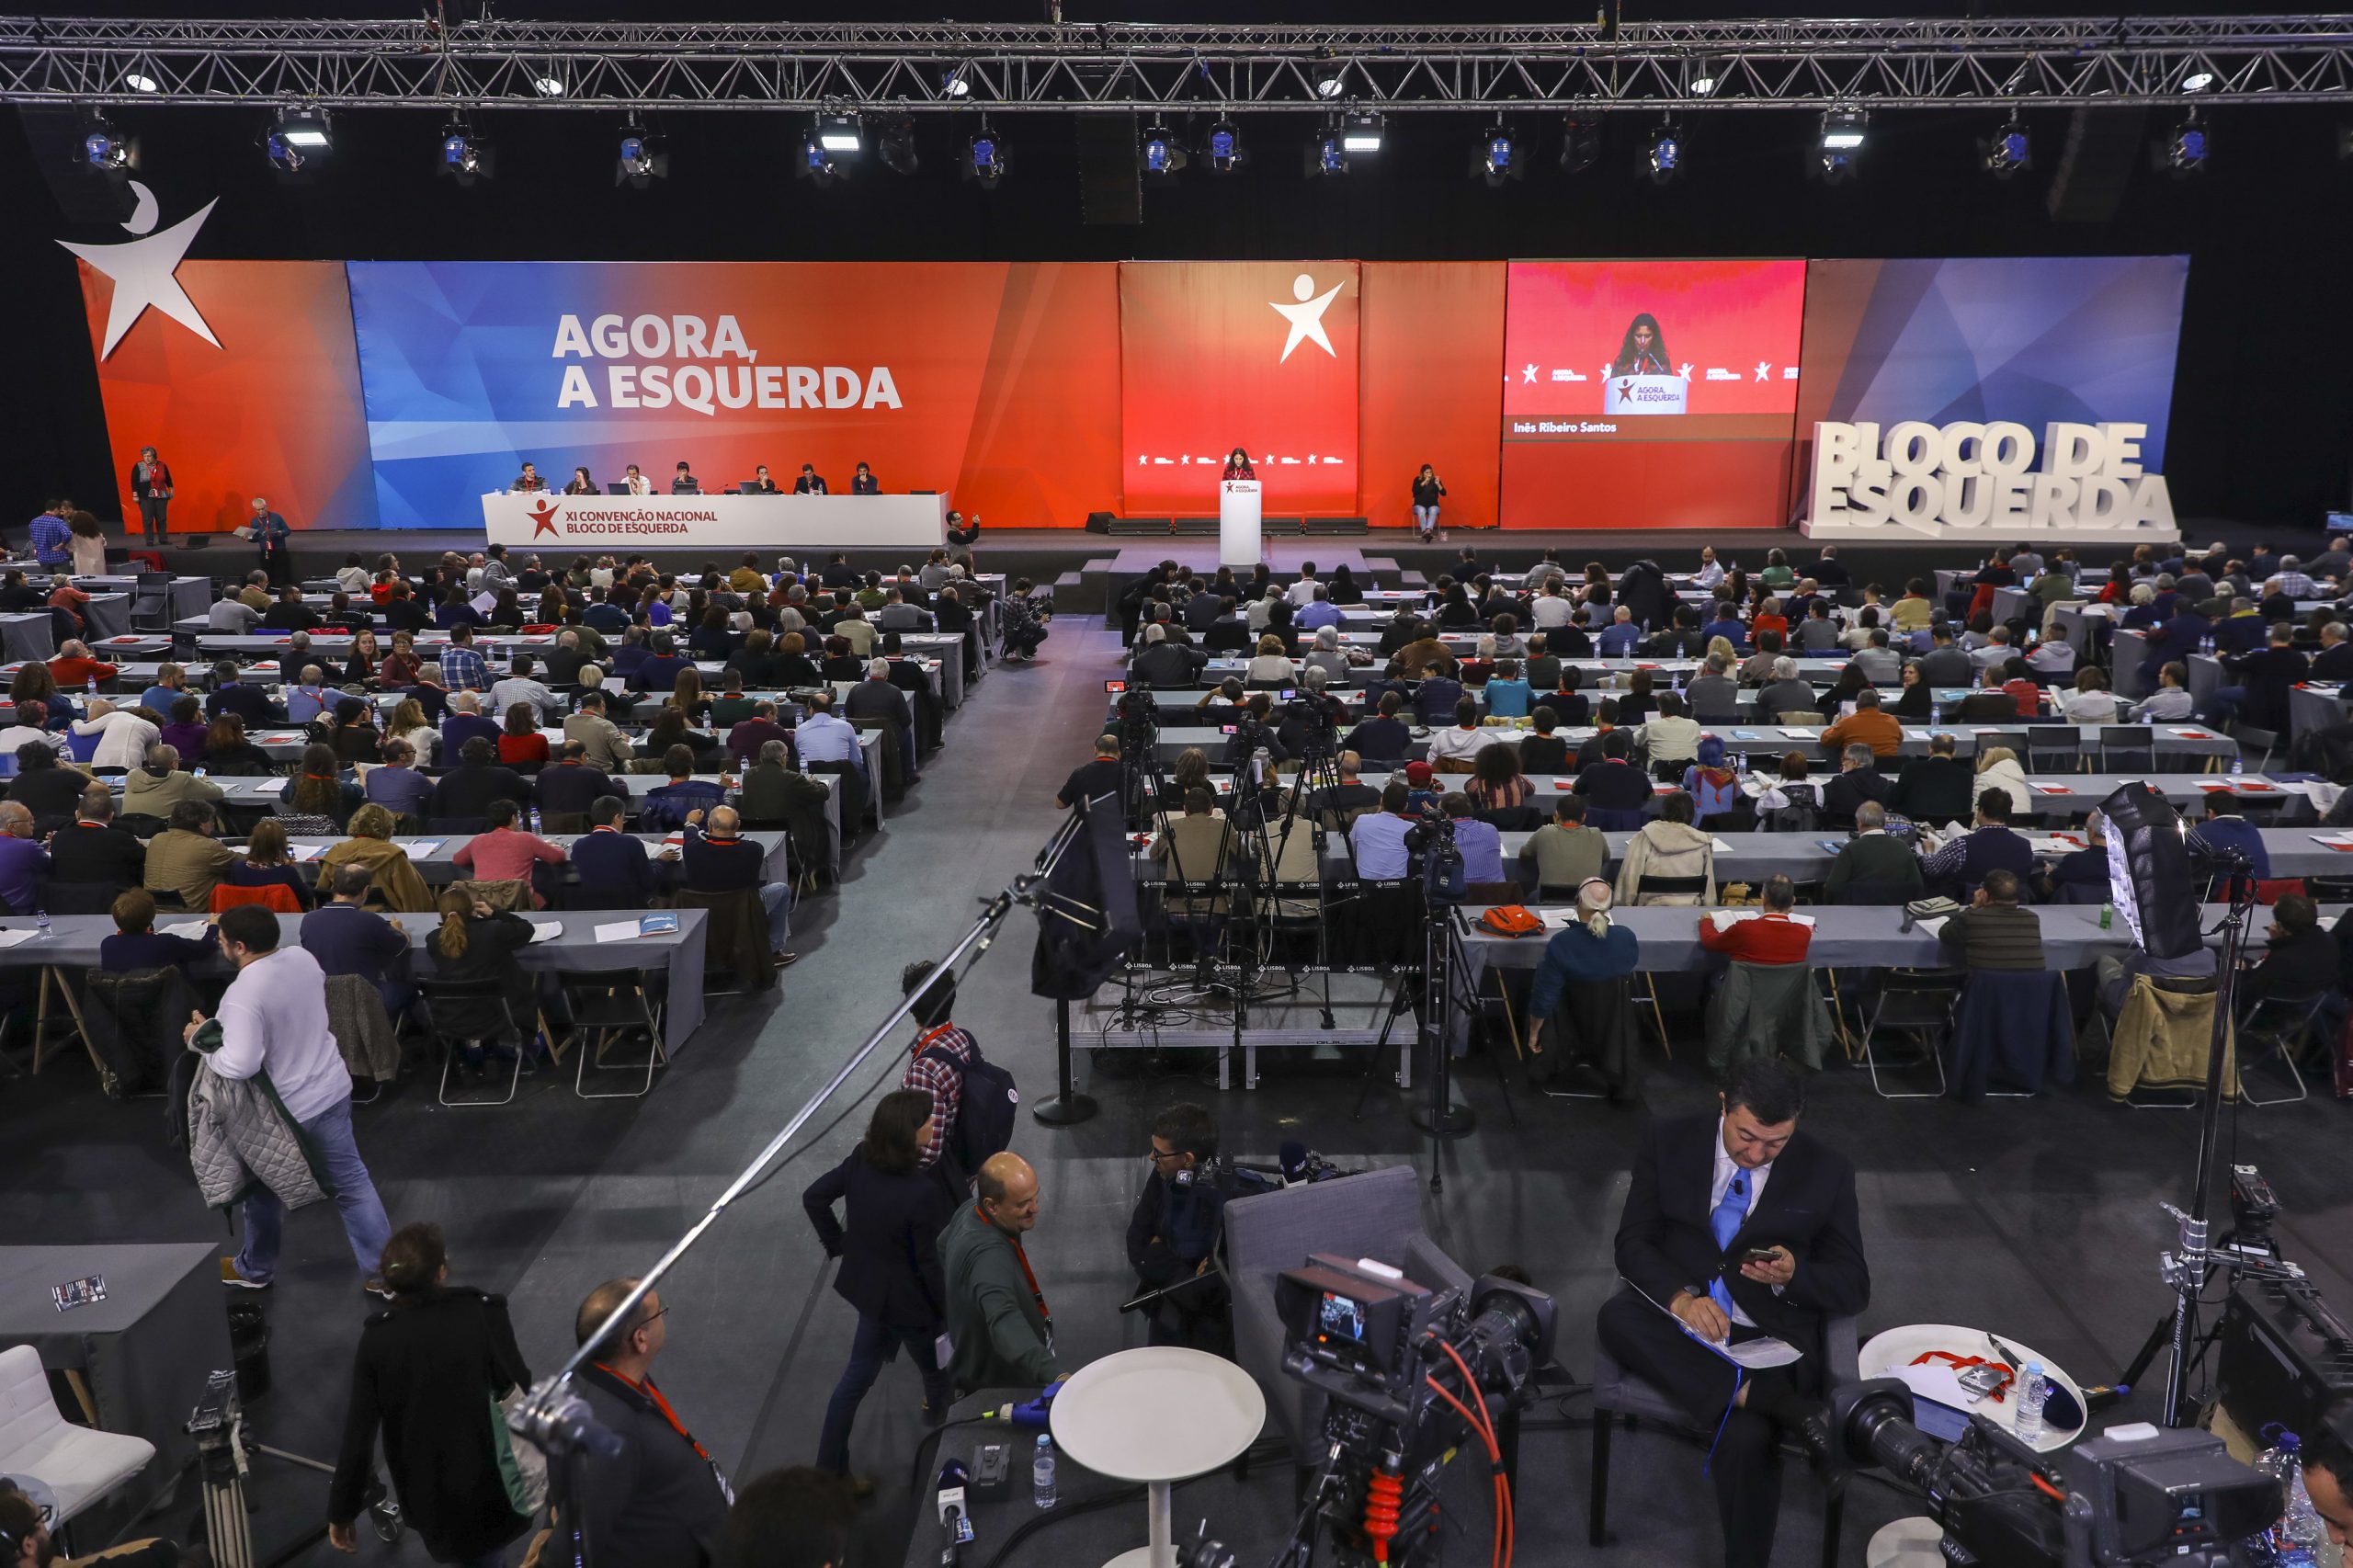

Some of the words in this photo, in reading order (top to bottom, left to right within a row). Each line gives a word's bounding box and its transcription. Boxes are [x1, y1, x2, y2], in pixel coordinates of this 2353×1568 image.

[552, 314, 757, 363] AGORA,
[558, 366, 598, 408] A
[608, 366, 904, 416] ESQUERDA
[1643, 394, 1680, 403] ESQUERDA
[1514, 422, 1536, 433] Inês
[1539, 421, 1578, 433] Ribeiro
[1580, 421, 1617, 433] Santos
[1813, 421, 2036, 479] BLOCO
[2041, 421, 2147, 479] DE
[565, 511, 577, 522] XI
[579, 508, 654, 525] CONVENÇÃO
[656, 511, 718, 522] NACIONAL
[1812, 472, 2177, 538] ESQUERDA
[566, 523, 606, 534] BLOCO
[608, 523, 623, 534] DE
[626, 523, 688, 535] ESQUERDA
